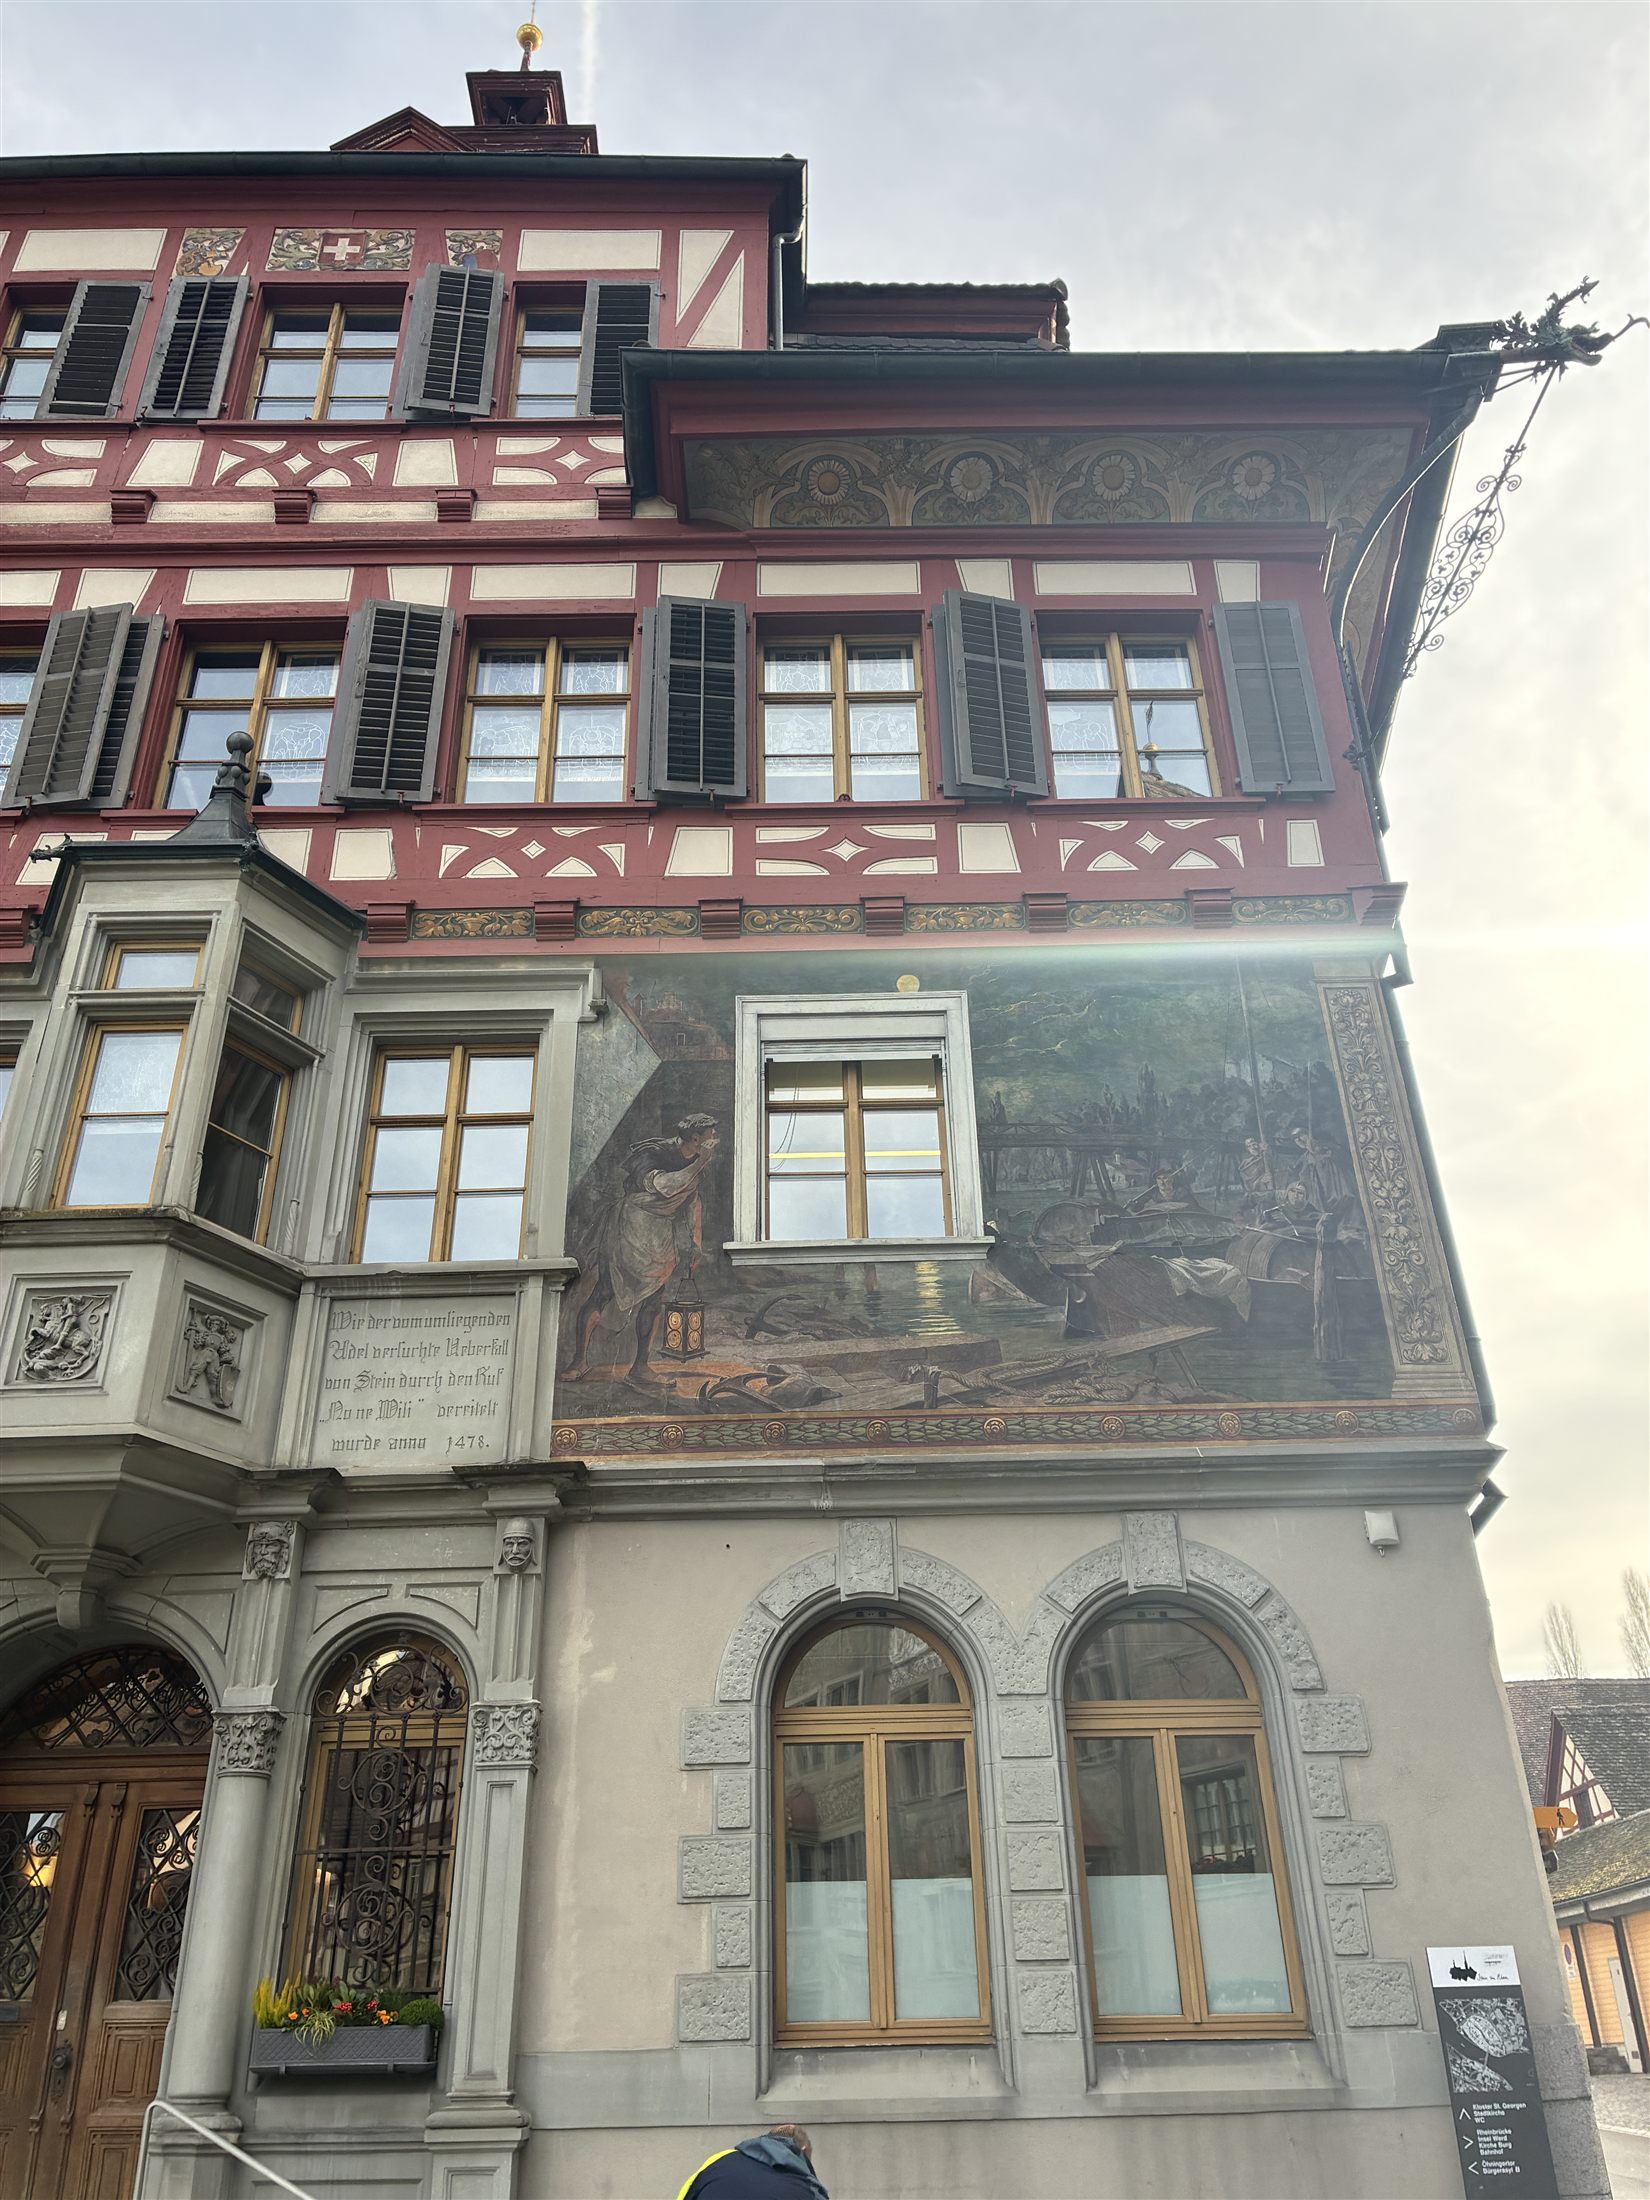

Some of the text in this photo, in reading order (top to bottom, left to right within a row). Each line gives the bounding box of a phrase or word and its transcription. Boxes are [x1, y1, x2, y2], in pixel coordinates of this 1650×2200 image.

[329, 1310, 511, 1334] Wie der vom umliegenden
[329, 1337, 510, 1364] Adel versuchte Ueberfall
[325, 1366, 504, 1394] von Stein durch den Ruf
[356, 1407, 374, 1420] ne
[437, 1399, 499, 1418] vereitelt
[332, 1434, 490, 1455] wurde anno 1478.
[1502, 2102, 1527, 2110] Georgen
[1497, 2141, 1512, 2149] Burg
[1483, 2167, 1514, 2175] Bürgerasyl
